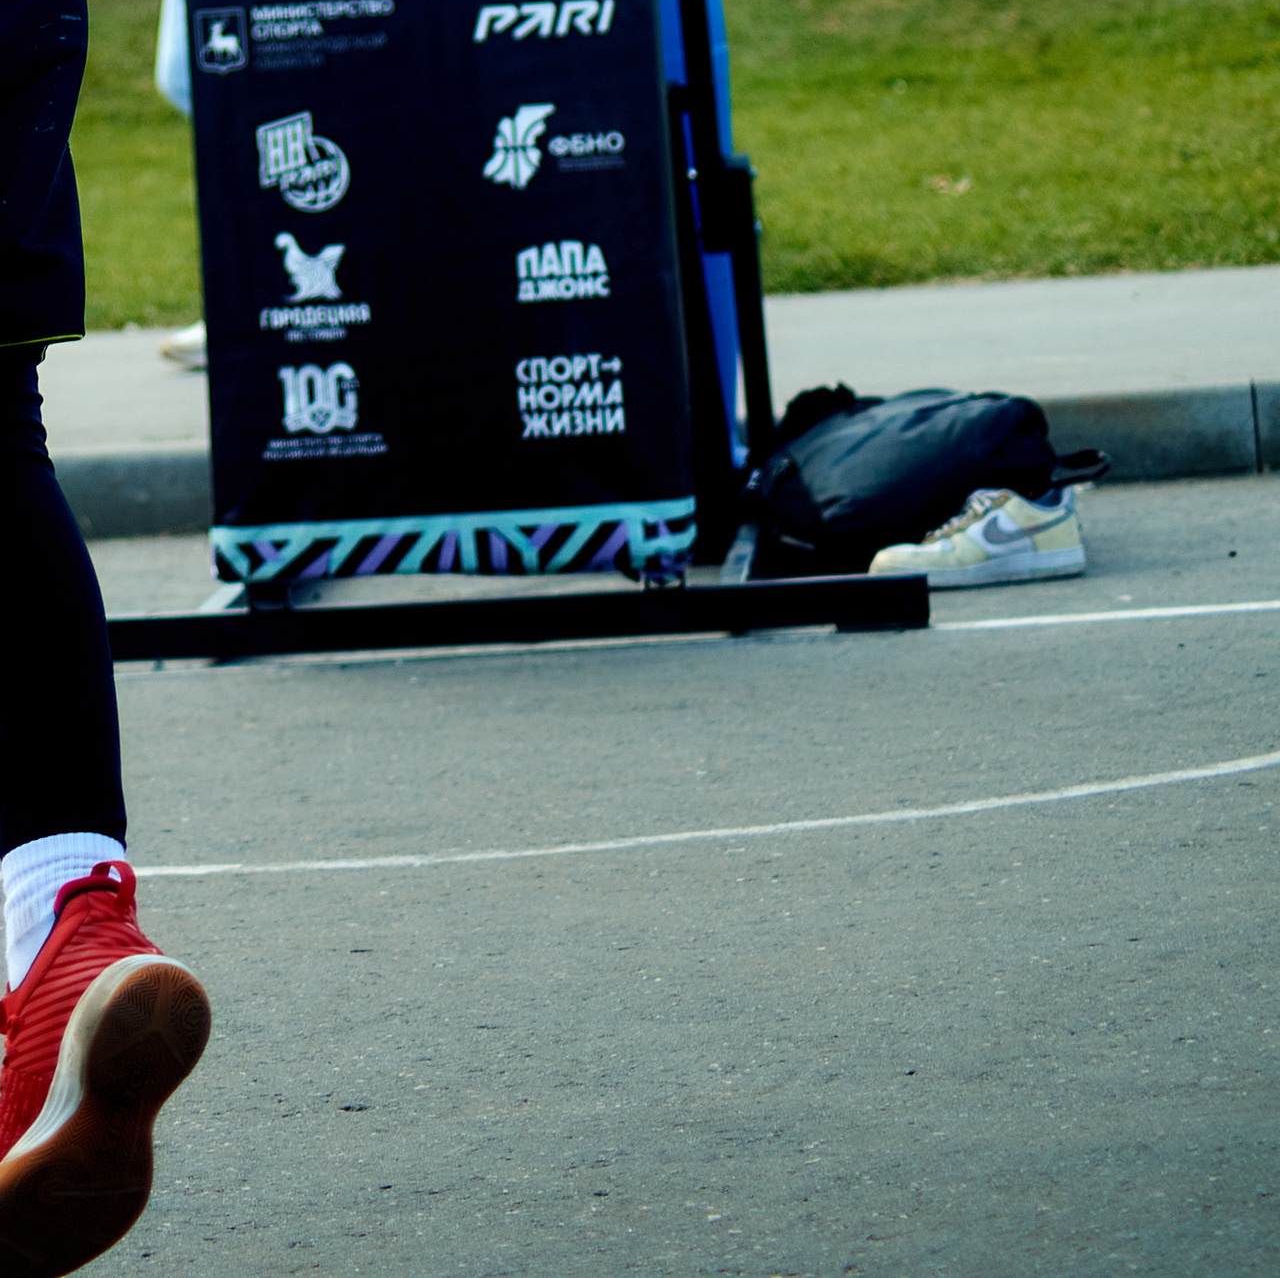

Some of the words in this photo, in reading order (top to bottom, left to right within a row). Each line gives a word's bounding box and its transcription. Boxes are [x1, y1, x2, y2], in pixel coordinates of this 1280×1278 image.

[548, 131, 625, 156] ФБНО
[517, 240, 608, 279] ПАПА
[518, 275, 610, 302] ДЖОНС
[516, 353, 602, 383] СПОРТ
[519, 379, 623, 410] НОРМА
[522, 407, 625, 437] ЖИЗНИ
